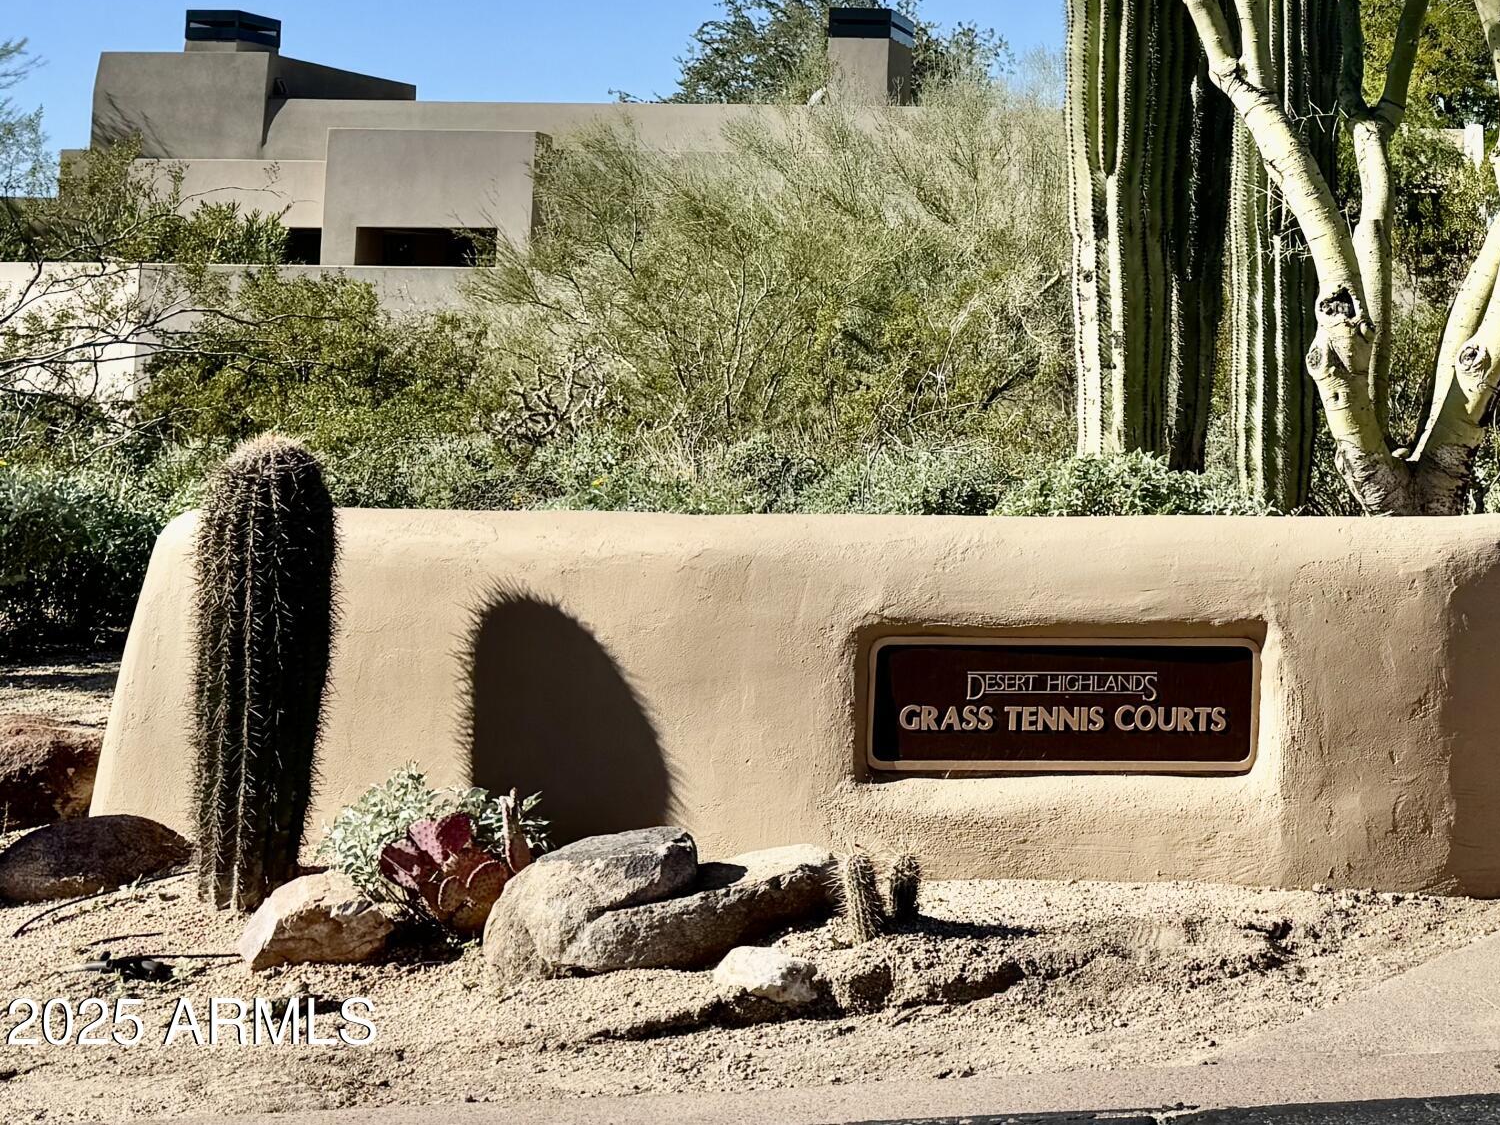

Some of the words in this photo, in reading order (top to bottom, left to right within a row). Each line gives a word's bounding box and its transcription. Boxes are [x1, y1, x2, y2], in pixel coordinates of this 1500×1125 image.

[965, 674, 1039, 701] DESERT
[1046, 674, 1158, 702] HIGHLANDS
[899, 704, 994, 732] GRASS
[1004, 706, 1105, 732] TENNIS
[1114, 704, 1227, 732] COURTS
